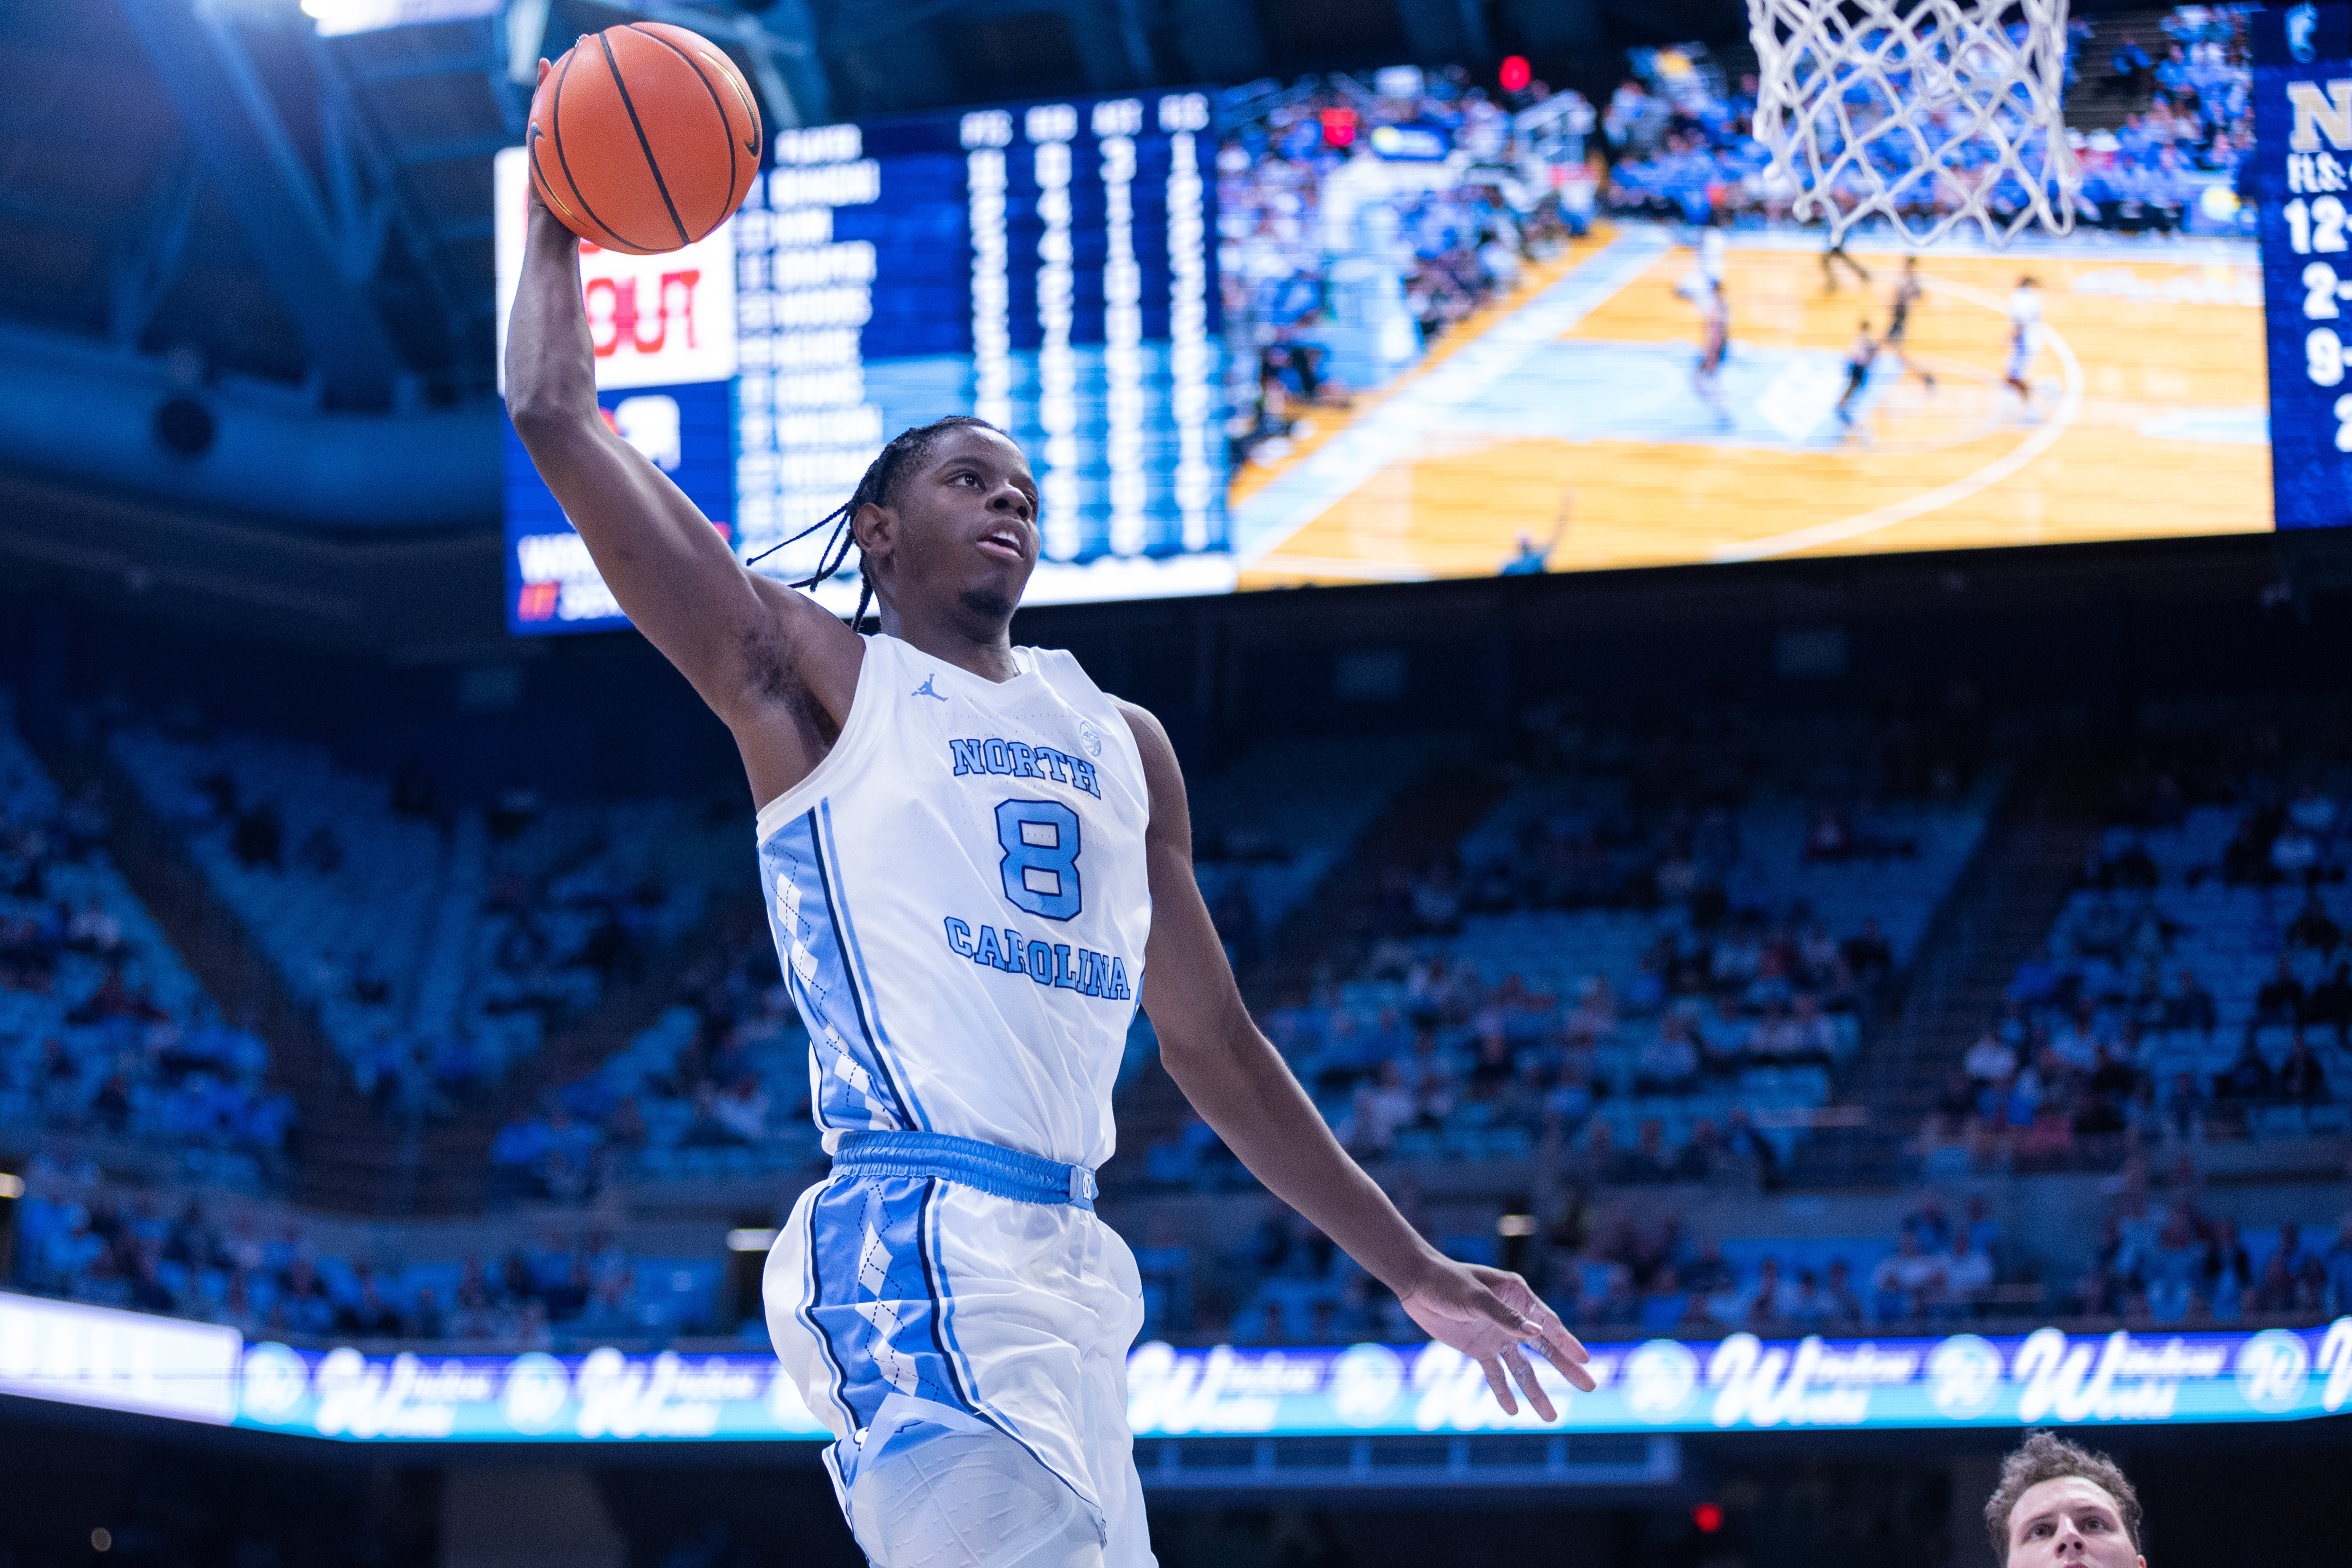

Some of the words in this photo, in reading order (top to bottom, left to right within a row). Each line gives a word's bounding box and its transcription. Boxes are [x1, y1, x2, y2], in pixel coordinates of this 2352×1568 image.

[949, 738, 1101, 800] NORTH
[995, 799, 1081, 921] 8
[944, 916, 1130, 1000] CAROLINA
